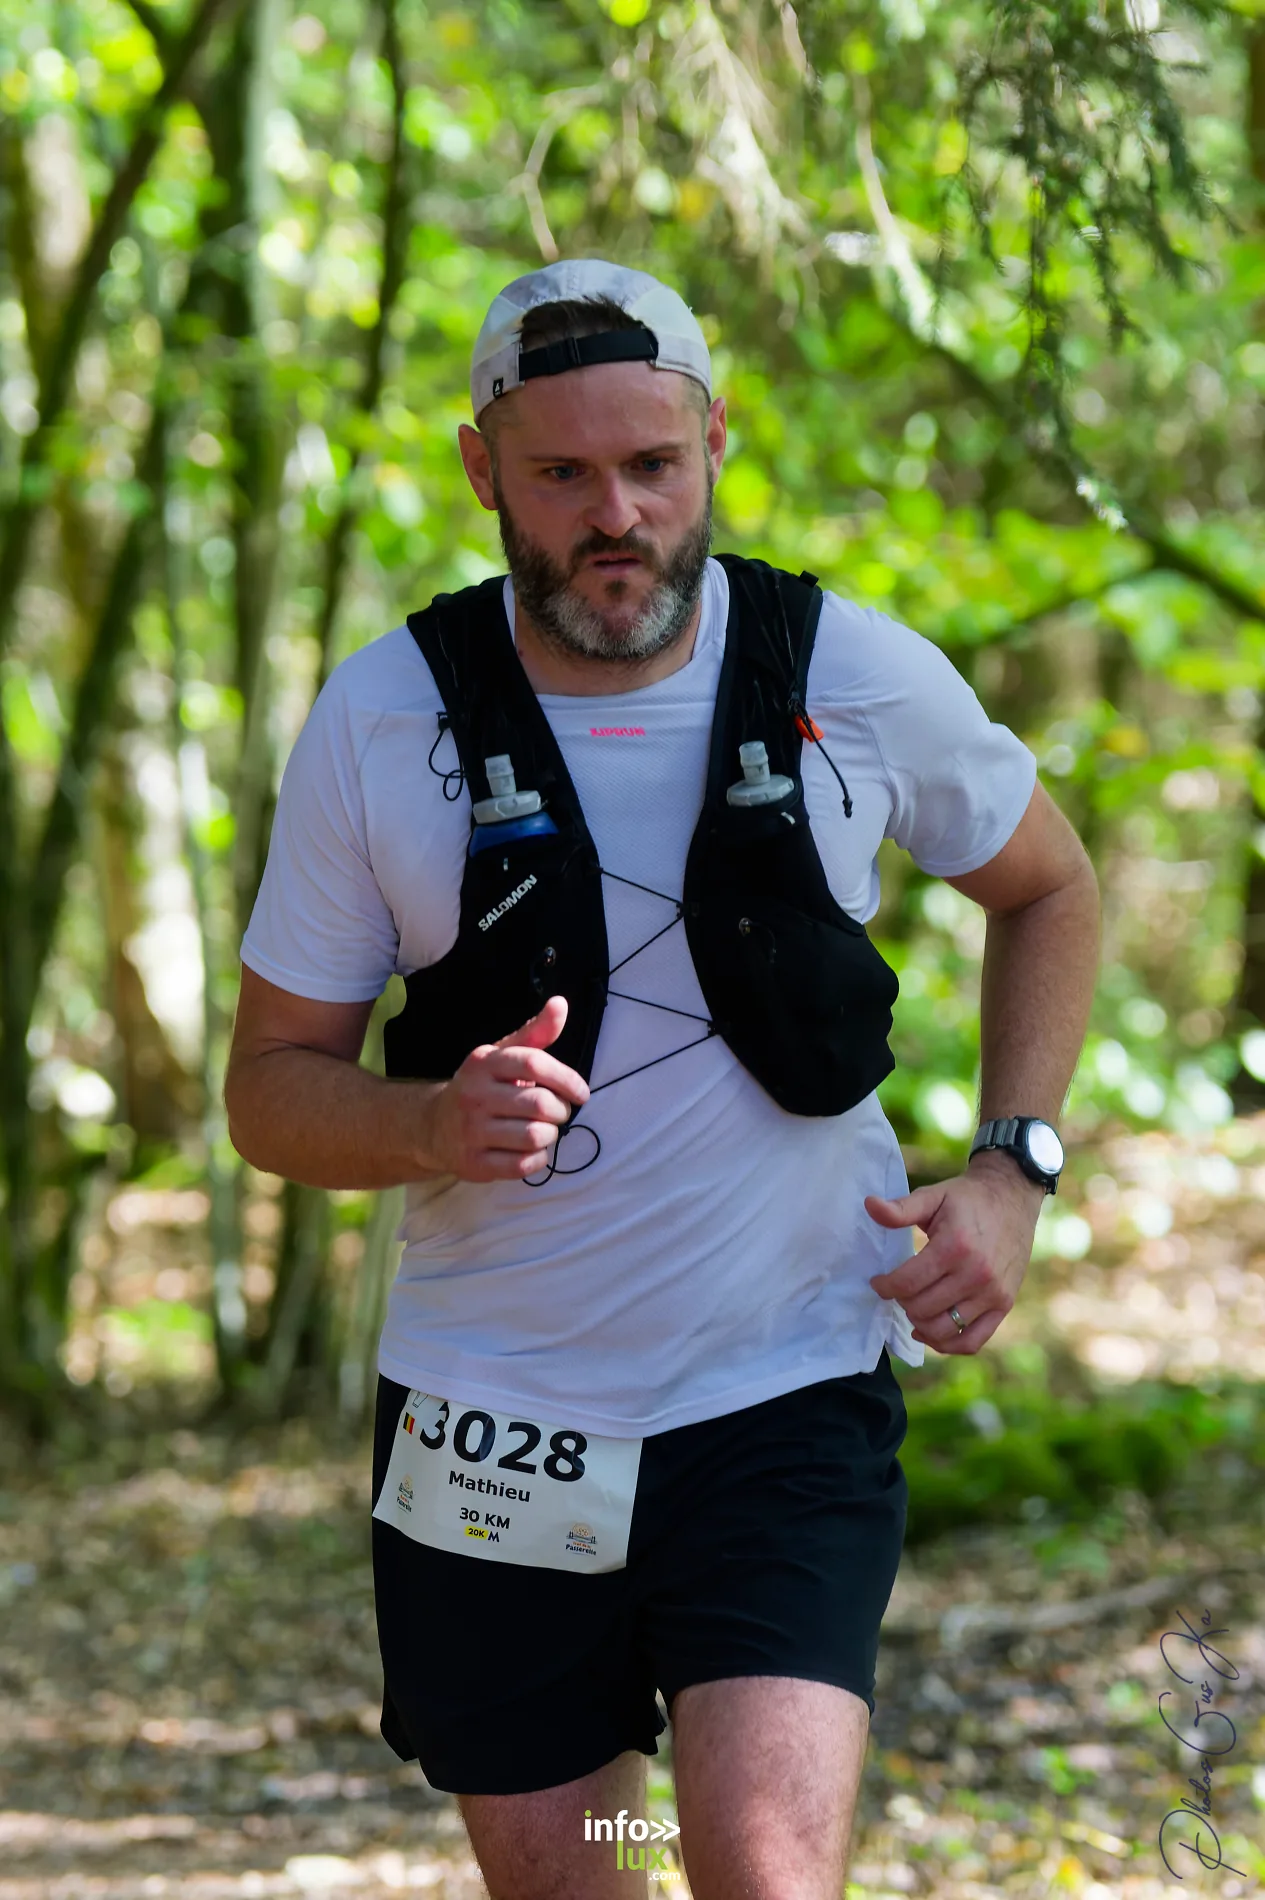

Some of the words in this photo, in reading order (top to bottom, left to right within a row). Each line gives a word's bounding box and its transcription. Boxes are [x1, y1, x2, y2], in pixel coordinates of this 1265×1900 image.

[478, 874, 538, 931] SALOMON
[420, 1402, 588, 1482] 3028
[449, 1471, 531, 1502] Mathieu
[460, 1507, 480, 1522] 30
[485, 1513, 510, 1529] KM
[468, 1528, 485, 1537] 20K
